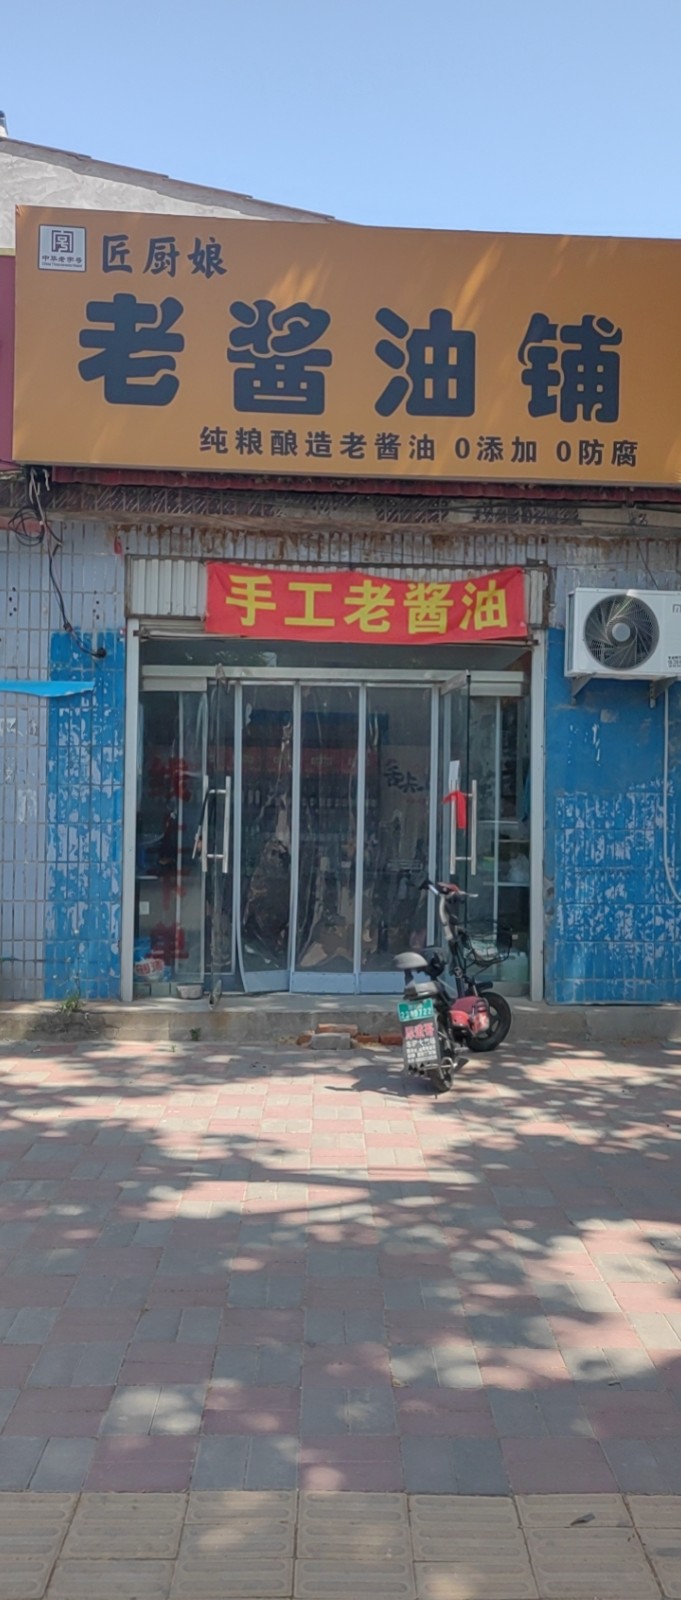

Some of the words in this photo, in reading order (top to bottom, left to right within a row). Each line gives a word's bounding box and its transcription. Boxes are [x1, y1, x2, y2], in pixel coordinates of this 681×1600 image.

[102, 234, 228, 278] 匠厨娘
[78, 293, 622, 423] 老酱油铺
[200, 426, 435, 461] 纯粮酿造老酱油
[455, 436, 537, 463] 0添加
[556, 440, 638, 467] 0防腐
[226, 575, 508, 634] 手工老酱油
